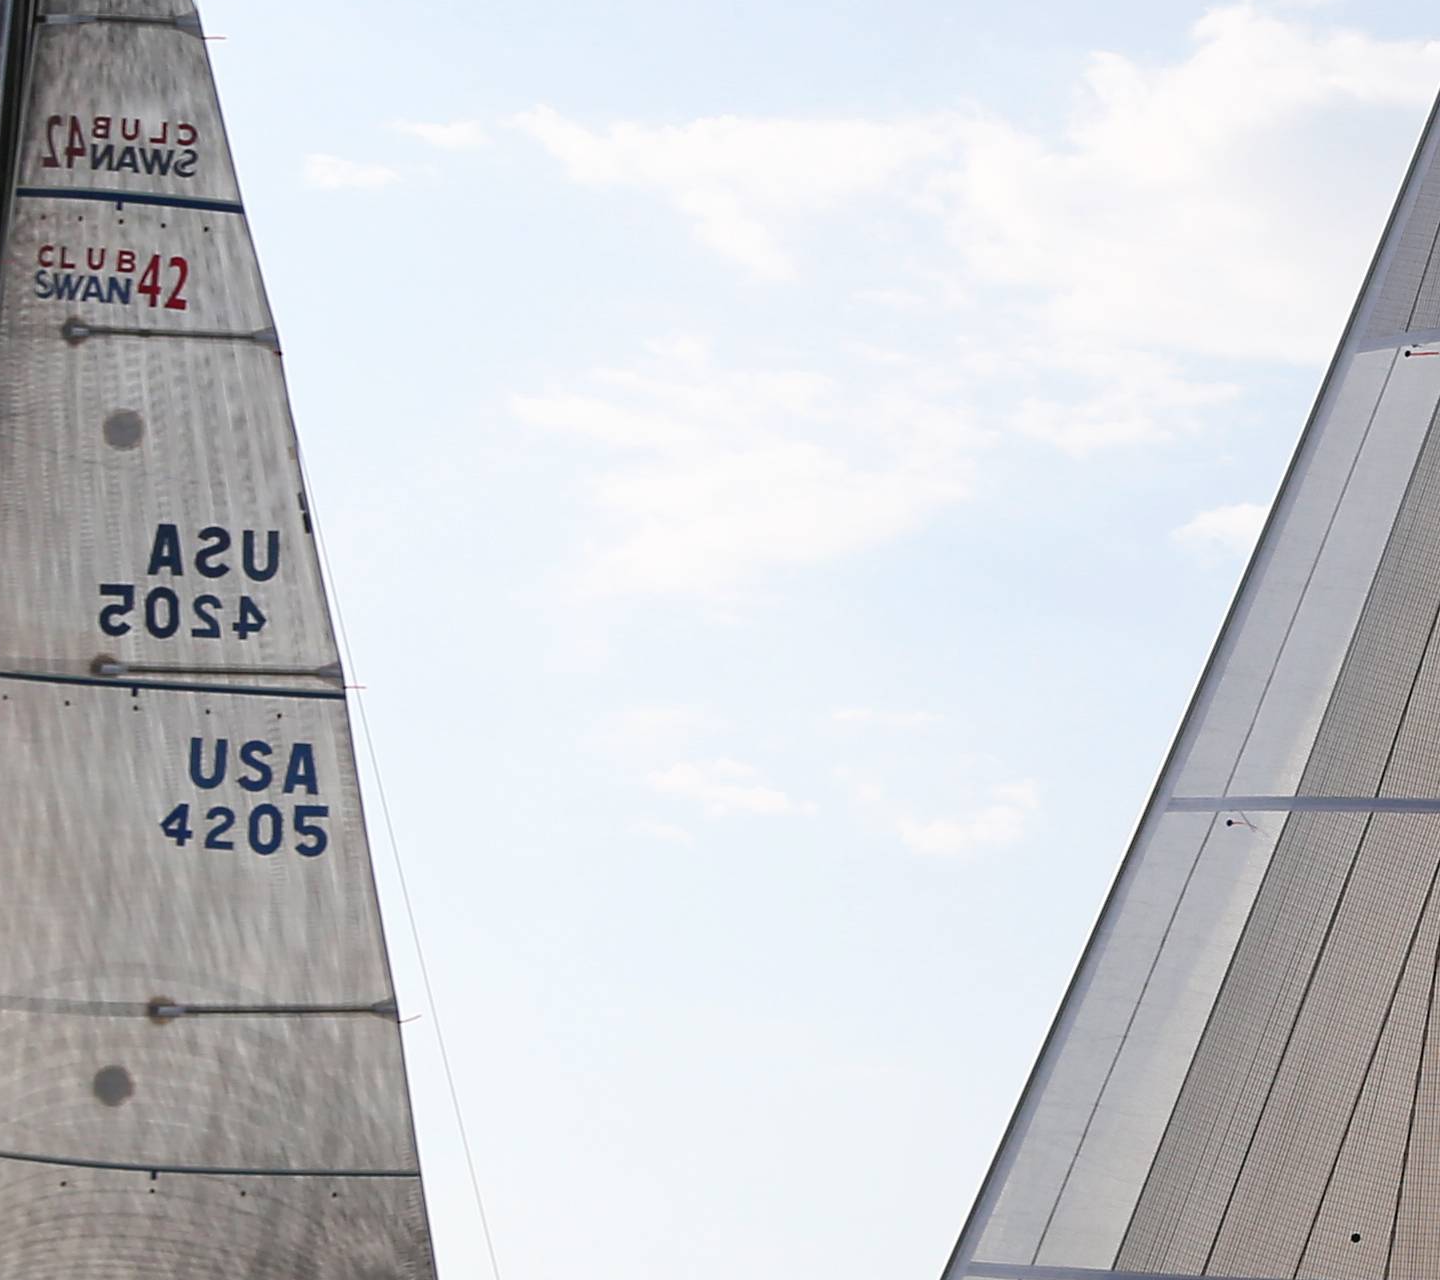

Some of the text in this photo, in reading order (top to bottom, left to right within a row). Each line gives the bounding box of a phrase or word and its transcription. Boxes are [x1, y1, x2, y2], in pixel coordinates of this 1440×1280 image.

[37, 245, 136, 273] CLUB
[137, 254, 188, 310] 42
[33, 270, 133, 305] SWAN
[188, 737, 319, 795] USA
[159, 803, 329, 857] 4205
